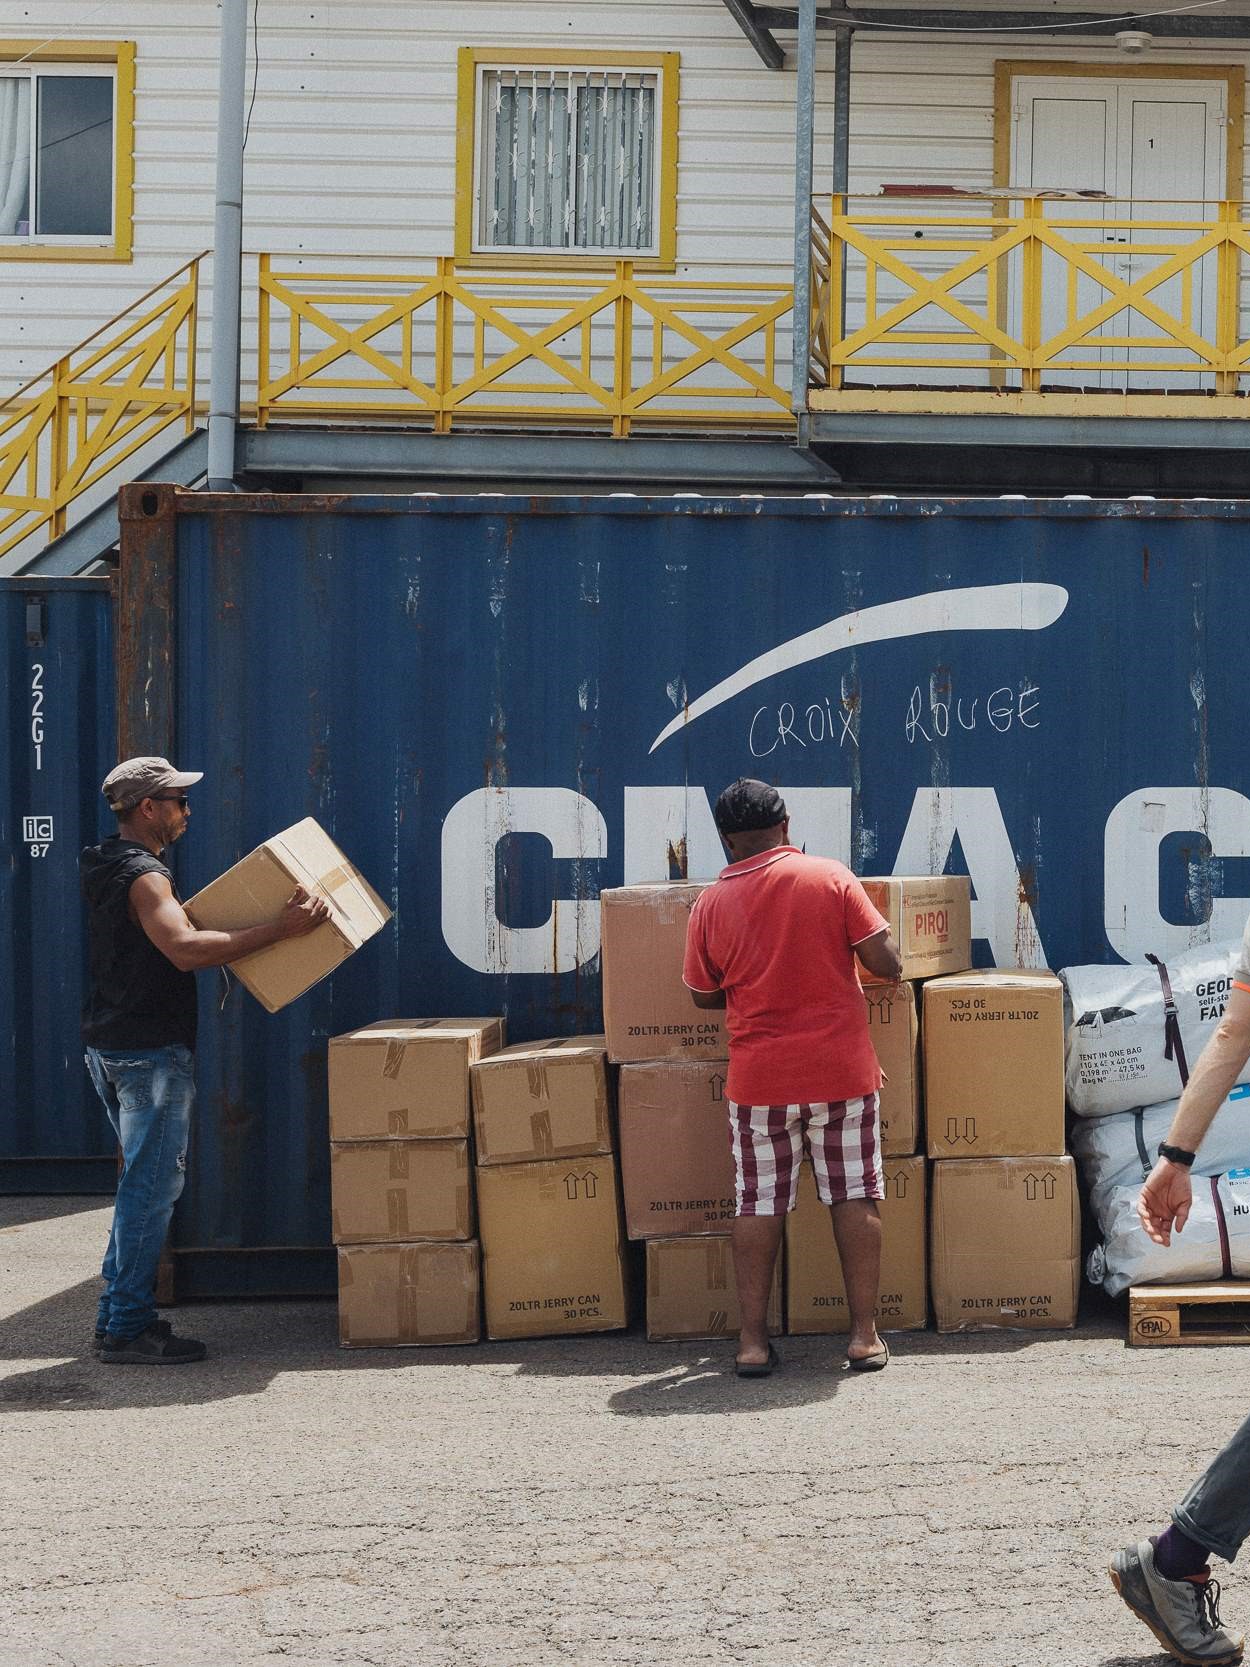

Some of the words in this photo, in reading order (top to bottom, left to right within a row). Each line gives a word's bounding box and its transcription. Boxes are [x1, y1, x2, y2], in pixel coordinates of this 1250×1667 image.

[31, 664, 44, 770] 22G1
[749, 697, 859, 757] CROIX
[905, 686, 1040, 743] ROUGE
[30, 844, 50, 858] 87
[915, 910, 949, 937] PIROI
[949, 999, 971, 1009] PCS.
[973, 999, 986, 1009] 30
[949, 1012, 972, 1022] CAN
[974, 1011, 1005, 1021] JERRY
[1008, 1010, 1039, 1020] 20LTR
[628, 1026, 660, 1036] 20LTR
[662, 1024, 694, 1035] JERRY
[697, 1024, 719, 1034] CAN
[681, 1037, 694, 1047] 30
[1099, 1051, 1107, 1059] IN
[1109, 1049, 1125, 1058] ONE
[1126, 1046, 1142, 1055] BAG
[649, 1201, 682, 1211] 20LTR
[685, 1200, 716, 1210] JERRY
[704, 1212, 717, 1221] 30
[509, 1301, 541, 1311] 20LTR
[543, 1297, 575, 1309] JERRY
[578, 1294, 600, 1305] CAN
[812, 1297, 844, 1307] 20LTR
[881, 1294, 903, 1304] CAN
[961, 1299, 993, 1309] 20LTR
[996, 1297, 1028, 1308] JERRY
[1030, 1295, 1052, 1305] CAN
[564, 1310, 577, 1319] 30
[580, 1307, 603, 1318] PCS.
[881, 1307, 904, 1316] PCS.
[1015, 1310, 1027, 1319] 30
[1030, 1308, 1052, 1317] PCS.
[1141, 1320, 1167, 1333] EPAL
